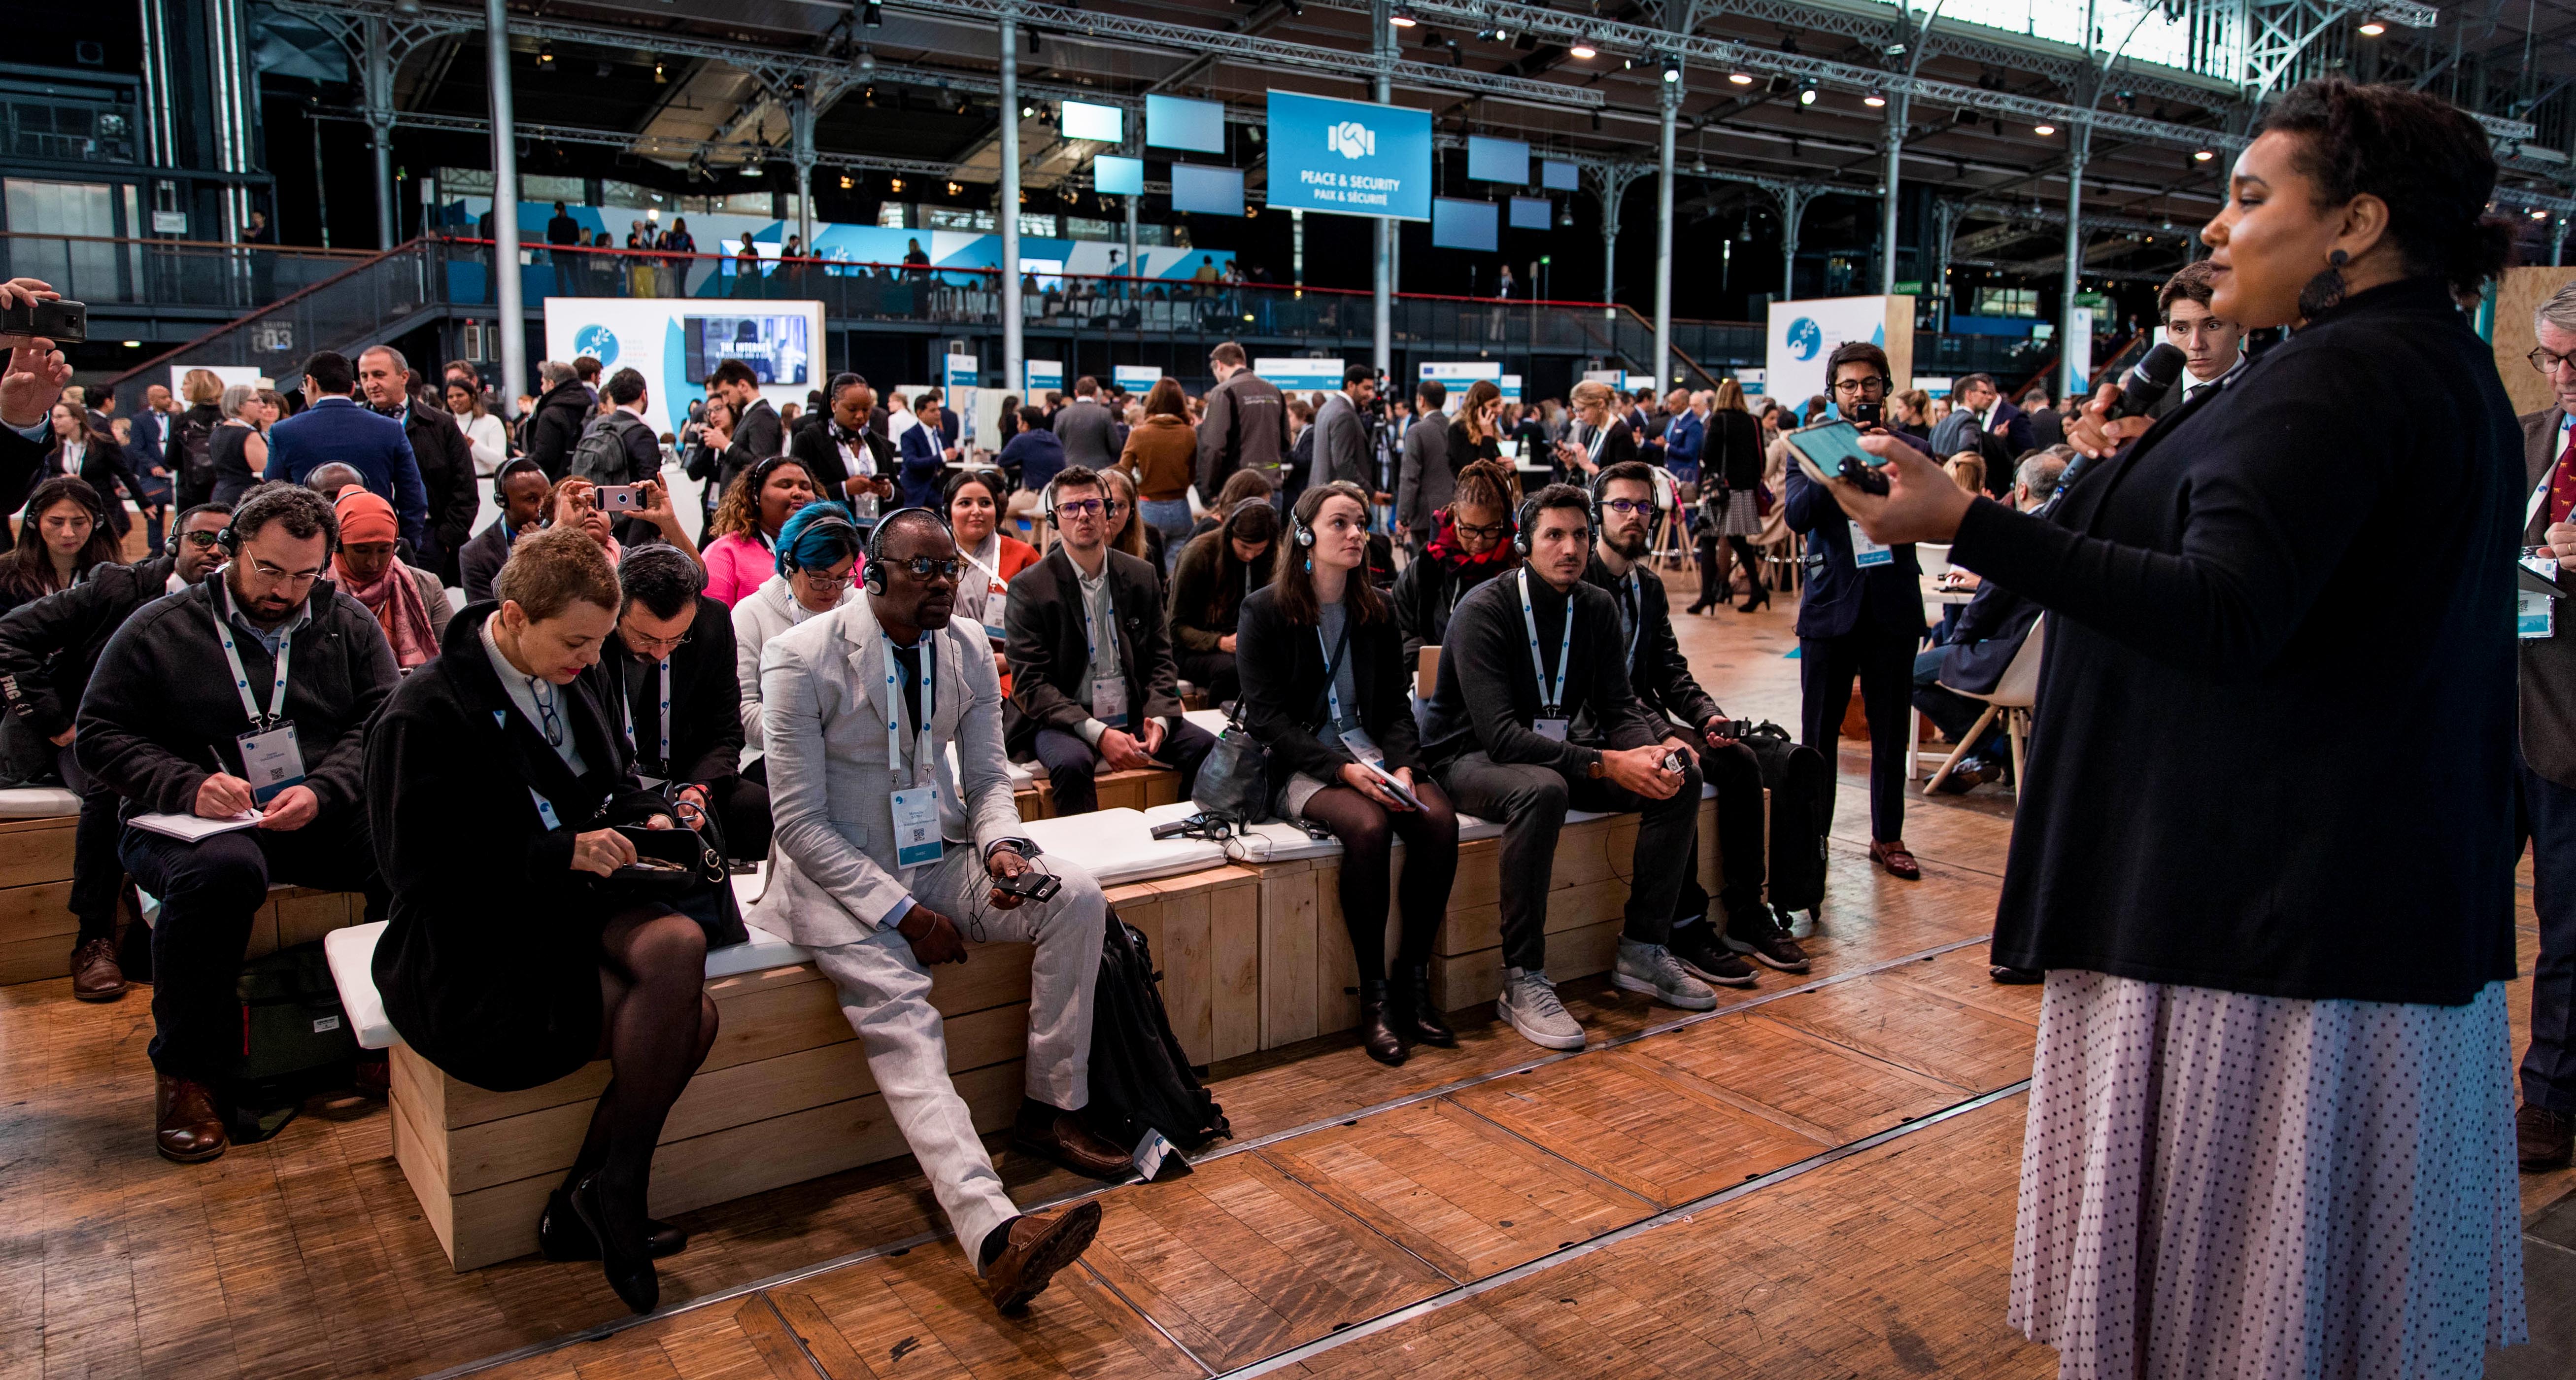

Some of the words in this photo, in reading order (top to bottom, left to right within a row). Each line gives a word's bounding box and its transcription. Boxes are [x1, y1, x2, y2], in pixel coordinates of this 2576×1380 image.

[1301, 170, 1336, 186] PEACE
[1338, 174, 1348, 187] &
[1350, 175, 1401, 192] SECURITY
[1314, 188, 1336, 201] PAIX
[1338, 191, 1346, 202] &
[720, 342, 734, 352] THE
[736, 342, 771, 353] INTERNET
